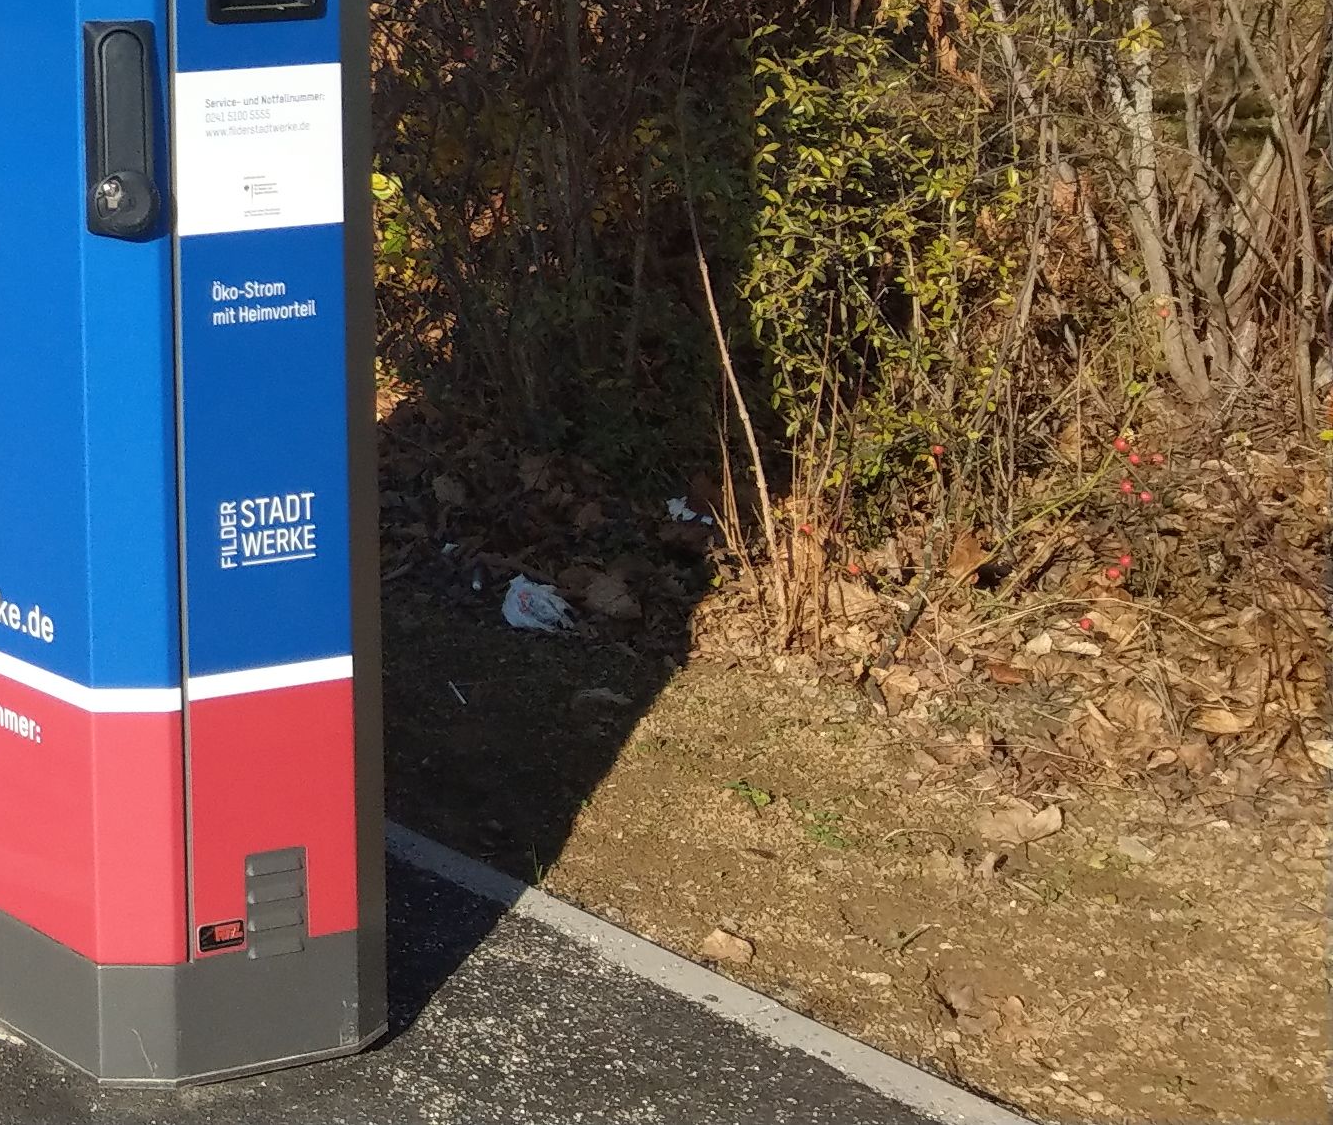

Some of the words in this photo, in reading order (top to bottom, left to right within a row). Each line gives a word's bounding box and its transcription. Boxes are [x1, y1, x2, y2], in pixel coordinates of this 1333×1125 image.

[204, 97, 242, 109] Service-
[243, 95, 259, 106] und
[227, 110, 248, 122] 5100
[249, 108, 271, 120] 5555
[212, 280, 286, 302] Öko-Strom
[212, 306, 236, 326] mit
[238, 299, 317, 324] Heimvorteil
[240, 492, 315, 528] STADT
[220, 500, 238, 569] FILDER
[241, 524, 317, 557] WERKE
